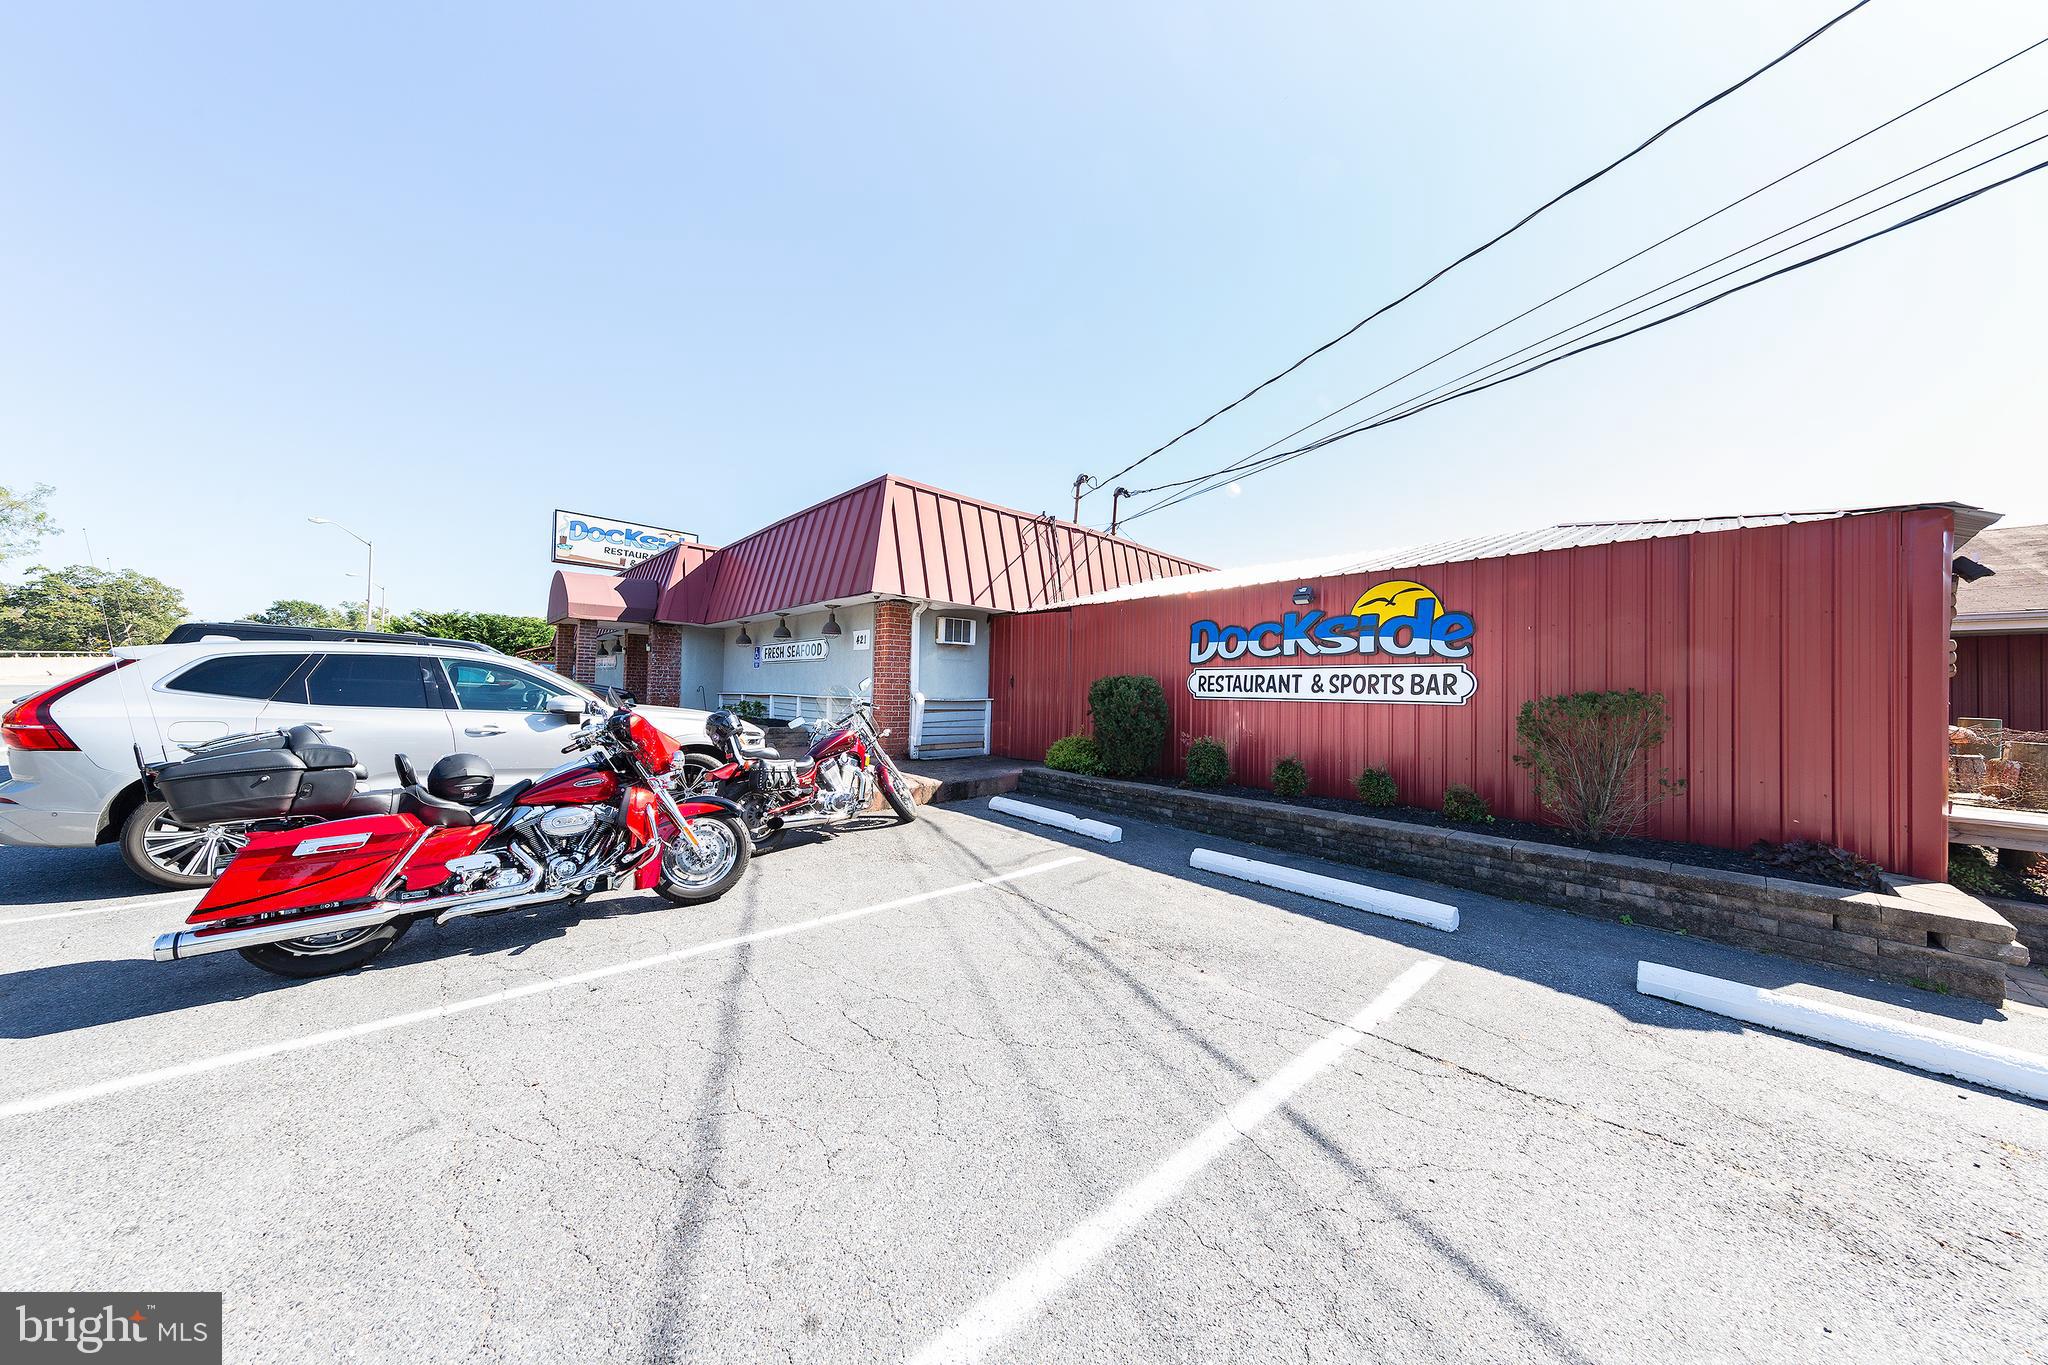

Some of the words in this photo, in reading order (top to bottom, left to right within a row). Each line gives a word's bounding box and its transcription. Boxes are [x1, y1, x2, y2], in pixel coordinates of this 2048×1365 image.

[764, 646, 784, 659] FRESH
[787, 642, 822, 658] SEAFOOD
[1198, 673, 1302, 694] RESTAURANT
[1311, 674, 1325, 694] &
[1329, 673, 1403, 695] SPORTS
[1409, 672, 1458, 696] BAR
